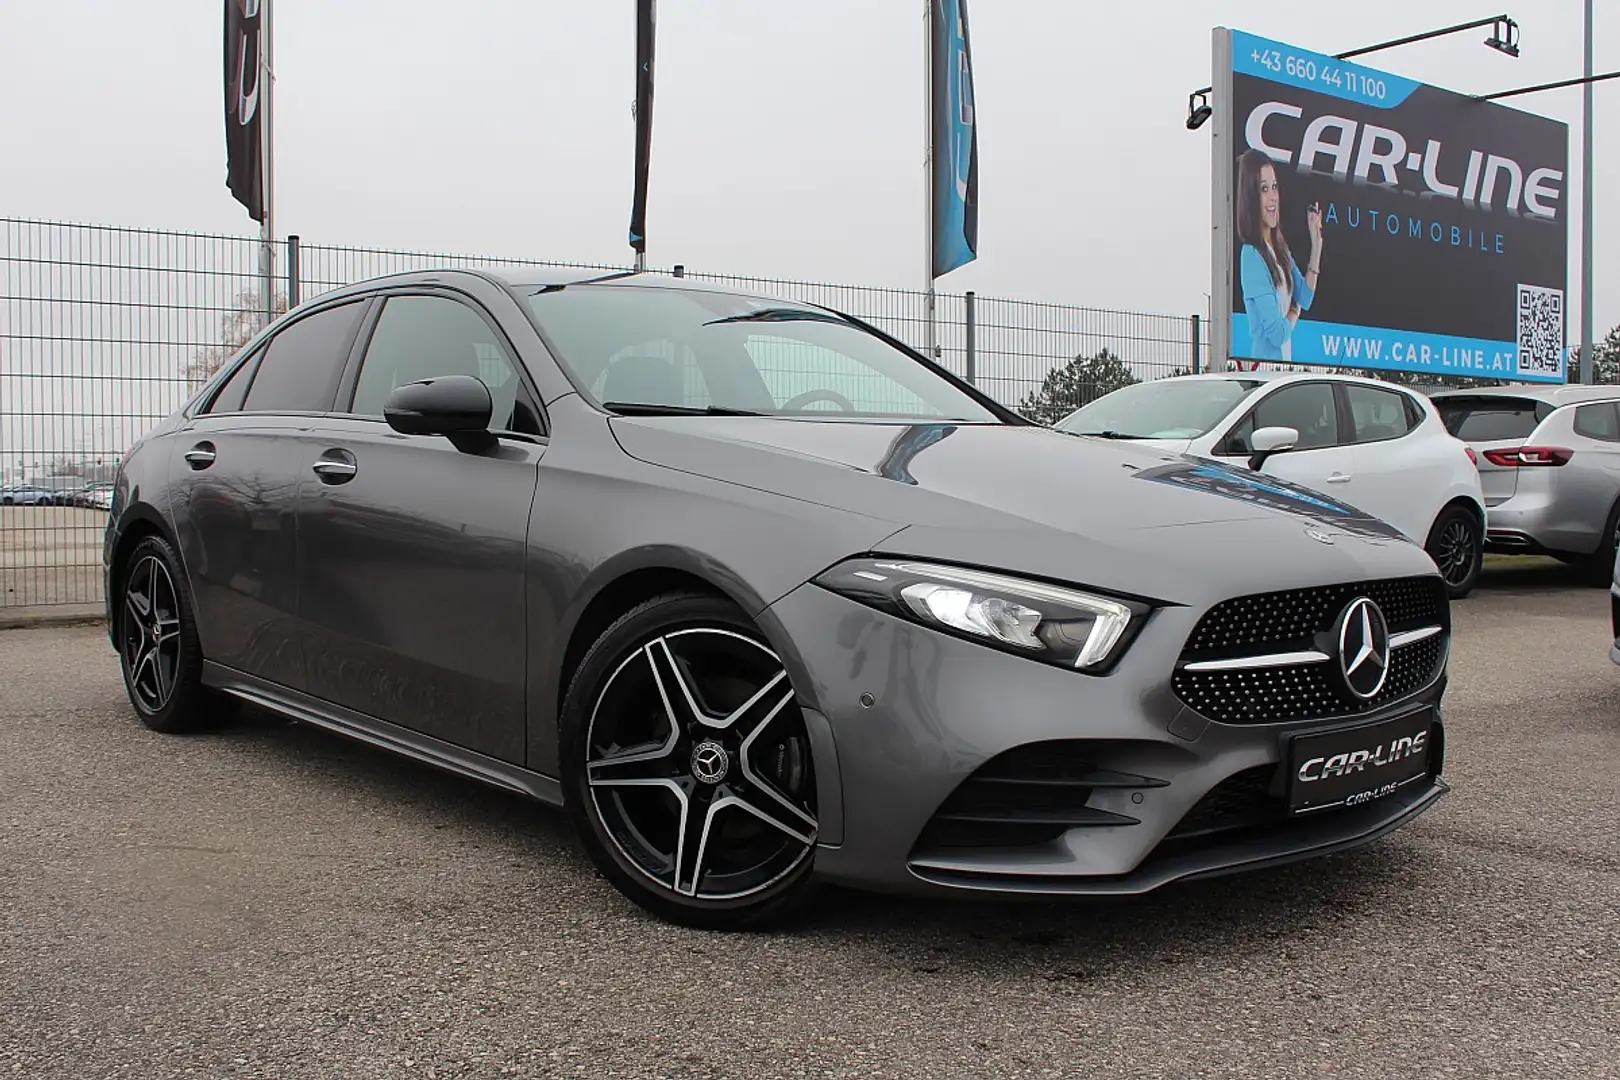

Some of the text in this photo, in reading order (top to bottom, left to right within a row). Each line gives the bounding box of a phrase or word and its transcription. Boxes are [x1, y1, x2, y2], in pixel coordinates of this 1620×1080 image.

[1251, 49, 1387, 100] +43 660 44 11 100
[1325, 203, 1505, 254] AUTOMOBILE
[1321, 335, 1513, 372] WWW.CAR-LINE.AT
